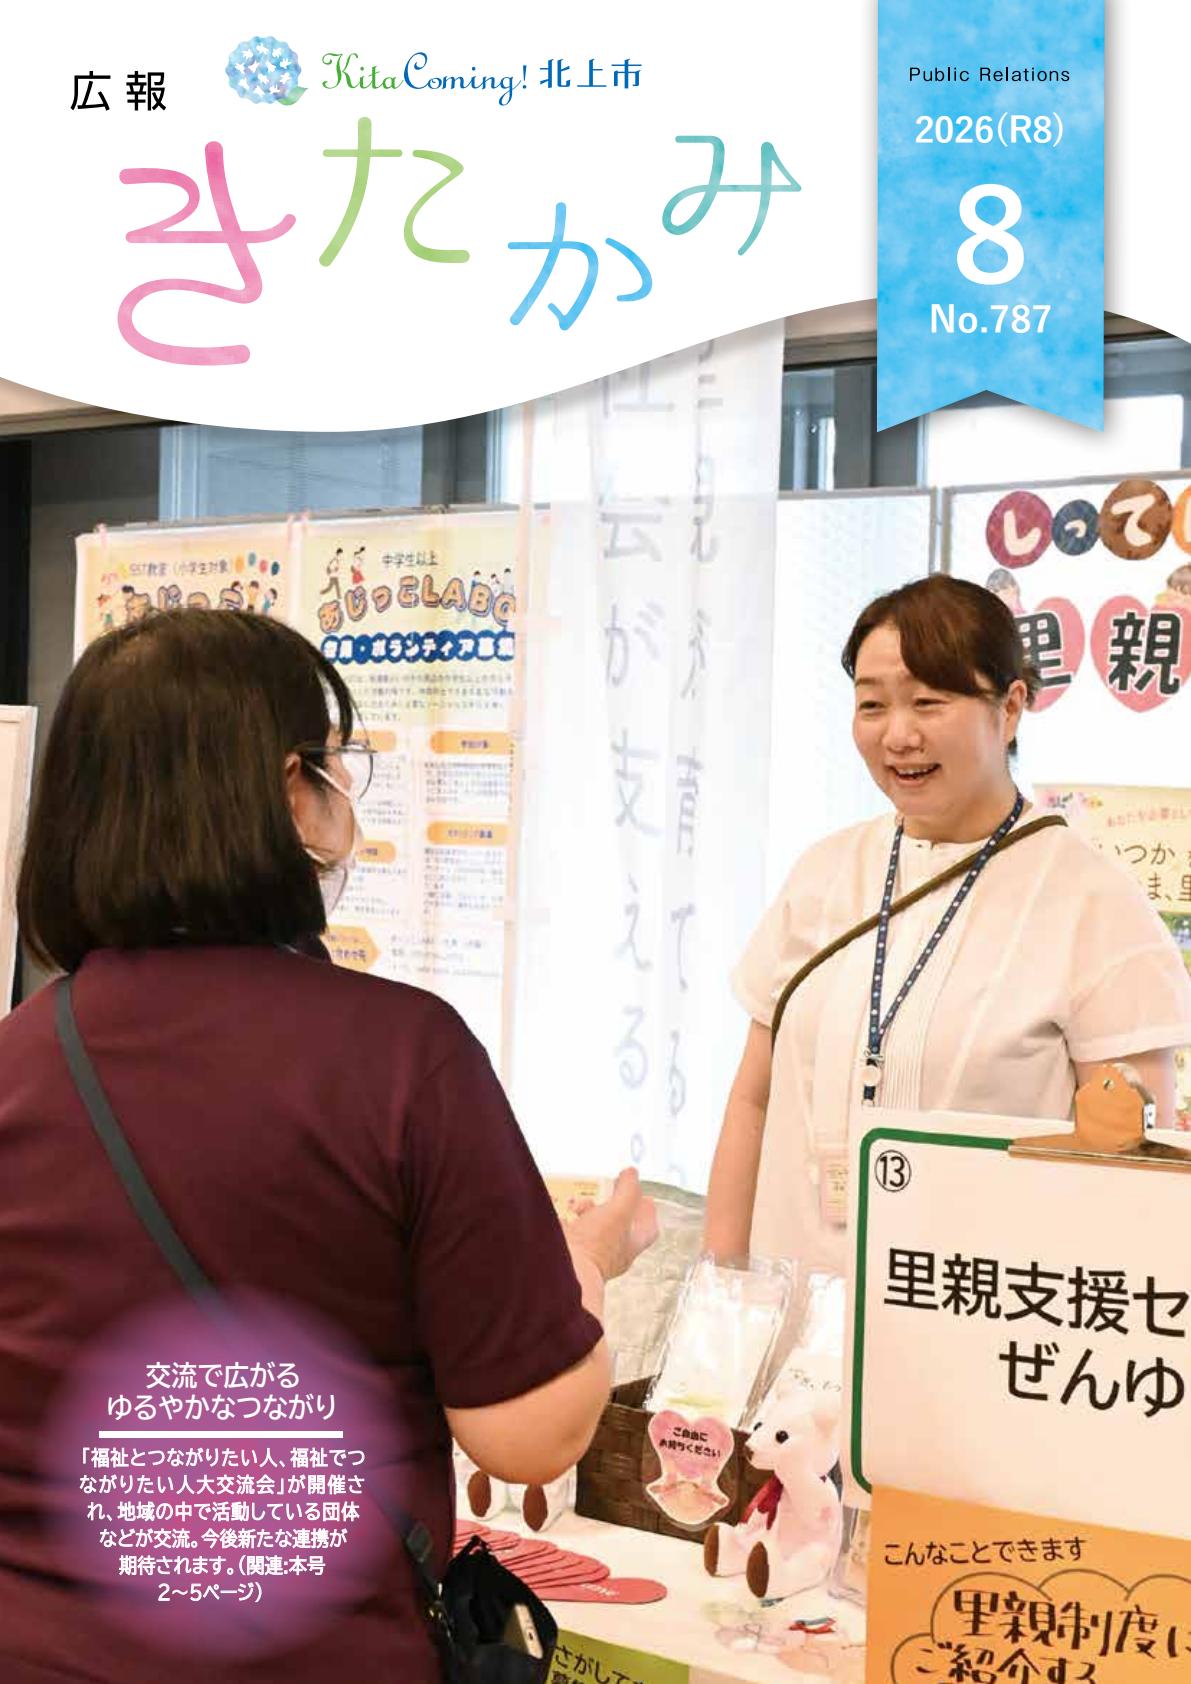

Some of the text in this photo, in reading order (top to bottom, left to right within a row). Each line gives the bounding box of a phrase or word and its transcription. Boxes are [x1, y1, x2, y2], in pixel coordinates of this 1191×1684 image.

[1003, 494, 1191, 556] しって
[1013, 612, 1182, 695] 里親
[884, 1248, 1190, 1338] 里親支援セ
[999, 1341, 1185, 1418] ぜんゆ
[885, 1536, 1086, 1566] こんなことできます
